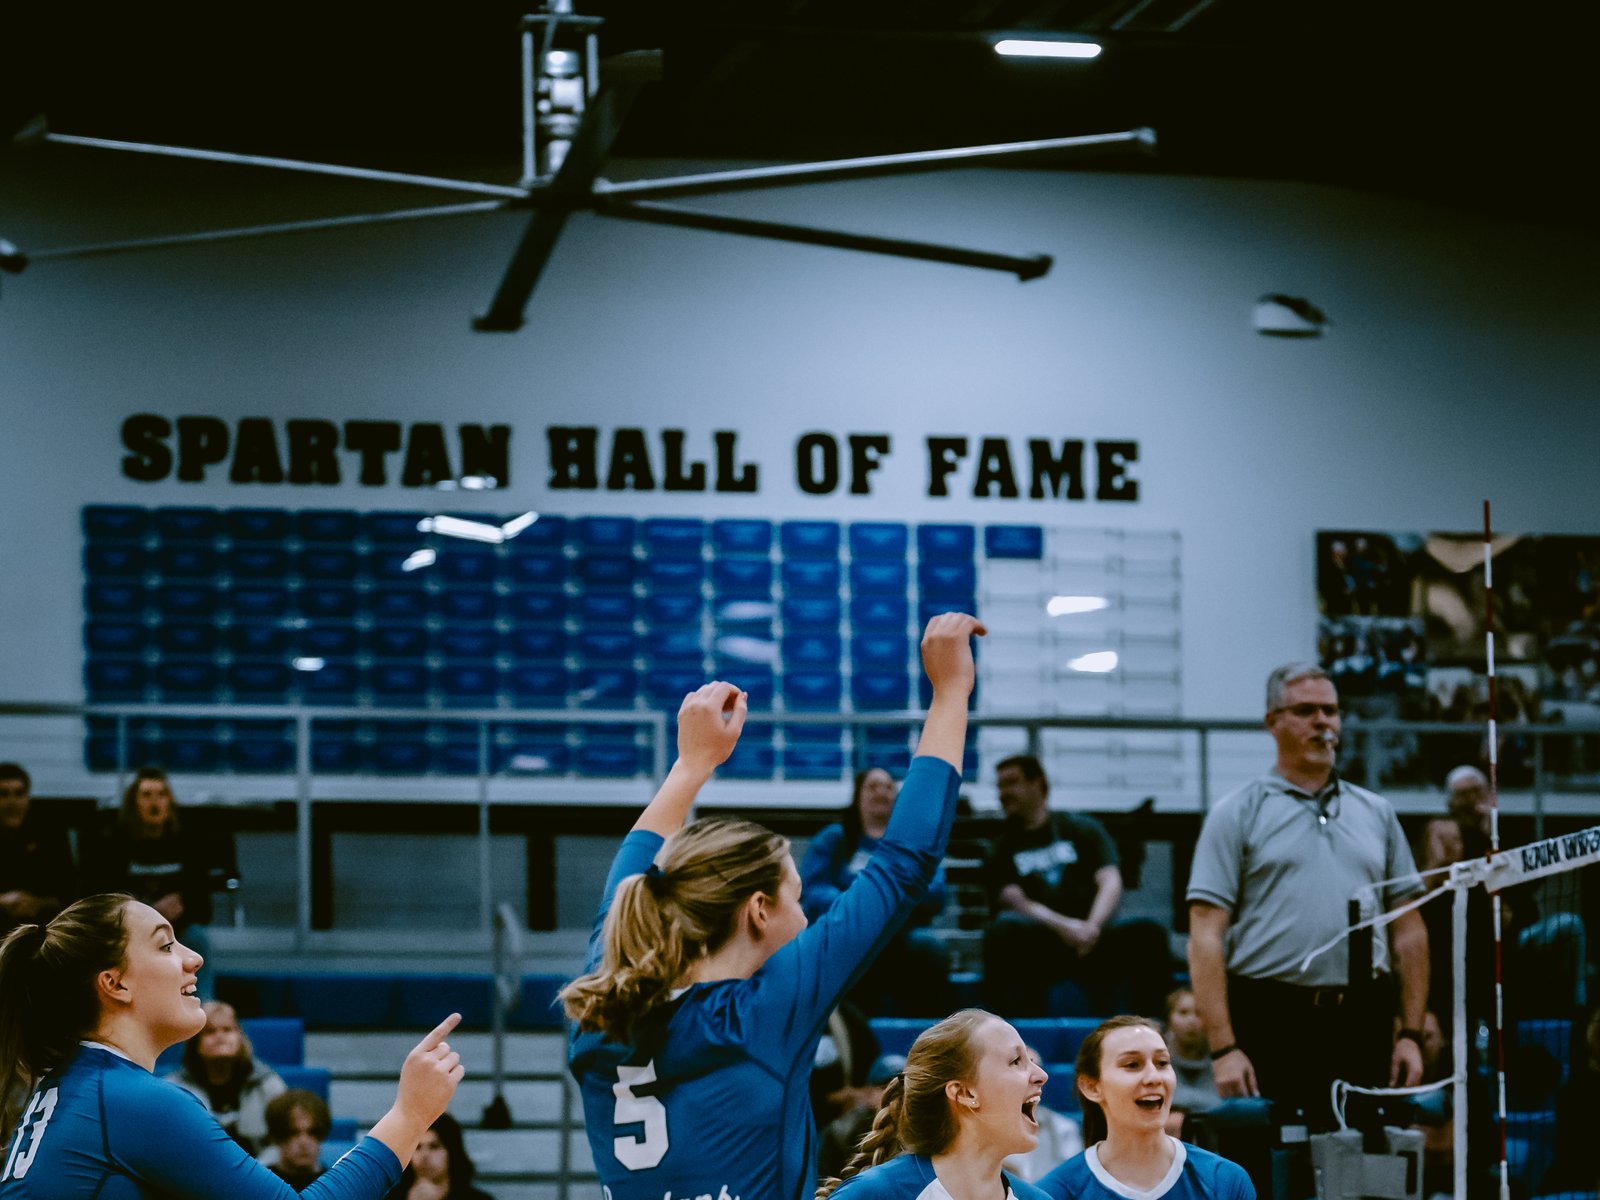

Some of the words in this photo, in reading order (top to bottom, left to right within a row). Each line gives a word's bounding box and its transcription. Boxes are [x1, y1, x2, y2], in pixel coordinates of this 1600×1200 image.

[120, 412, 513, 490] SPARTAN
[546, 426, 758, 493] HALL
[796, 433, 891, 495] OF
[926, 437, 1139, 502] FAME
[612, 1058, 670, 1172] 5
